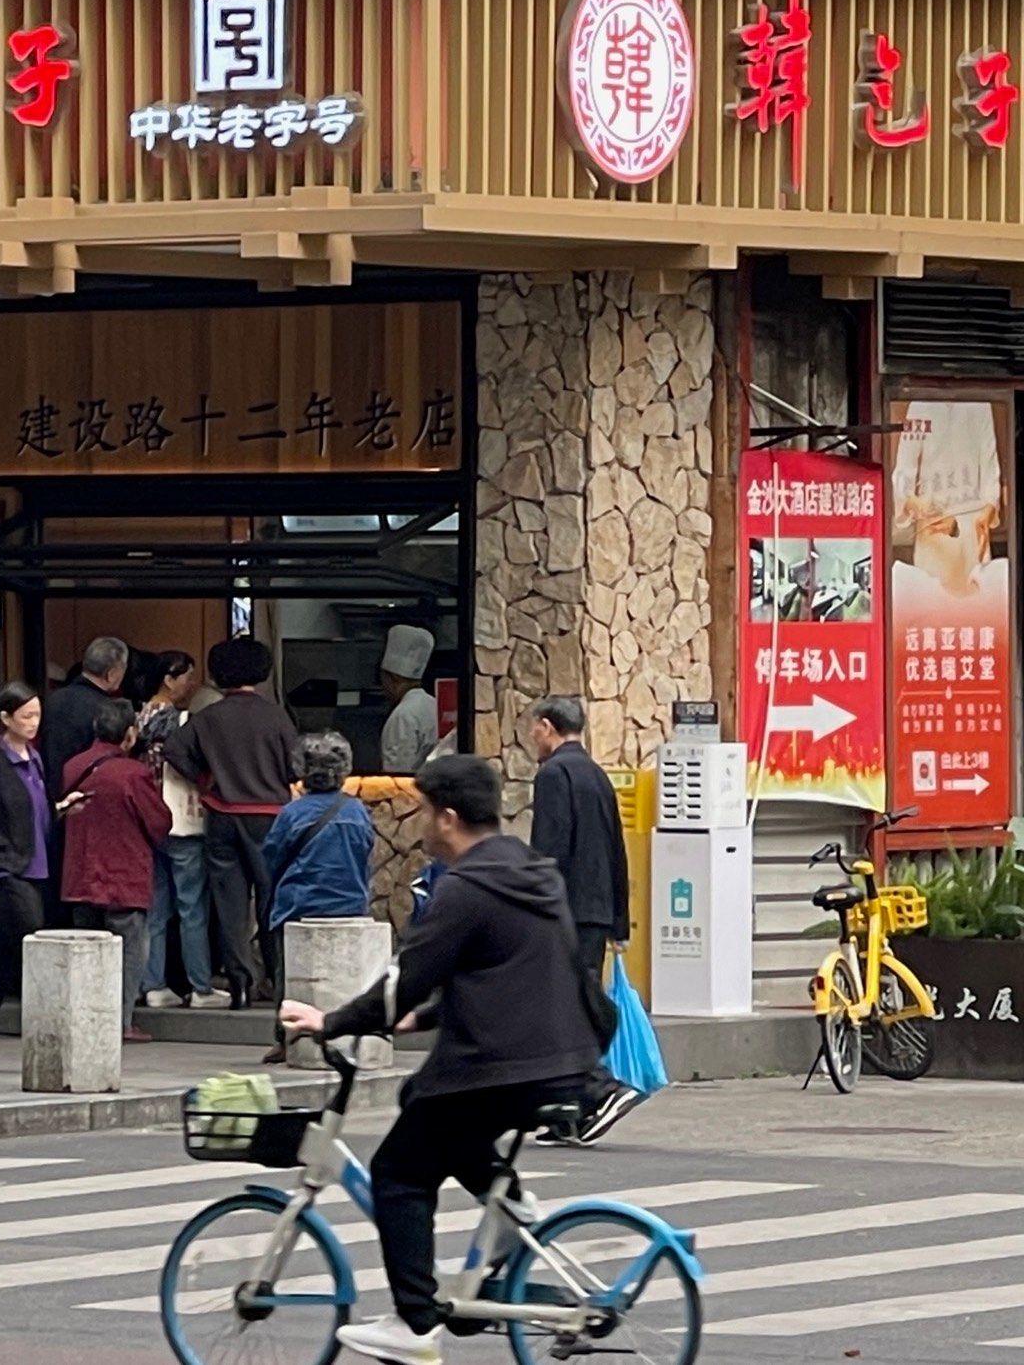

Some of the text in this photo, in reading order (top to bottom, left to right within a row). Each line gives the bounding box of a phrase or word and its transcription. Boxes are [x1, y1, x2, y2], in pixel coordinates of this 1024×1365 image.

[130, 98, 355, 151] 中华老字号
[16, 388, 456, 458] 建设路十二年老店
[746, 479, 875, 517] 金沙大酒店建设路店
[755, 647, 867, 685] 停车场入口
